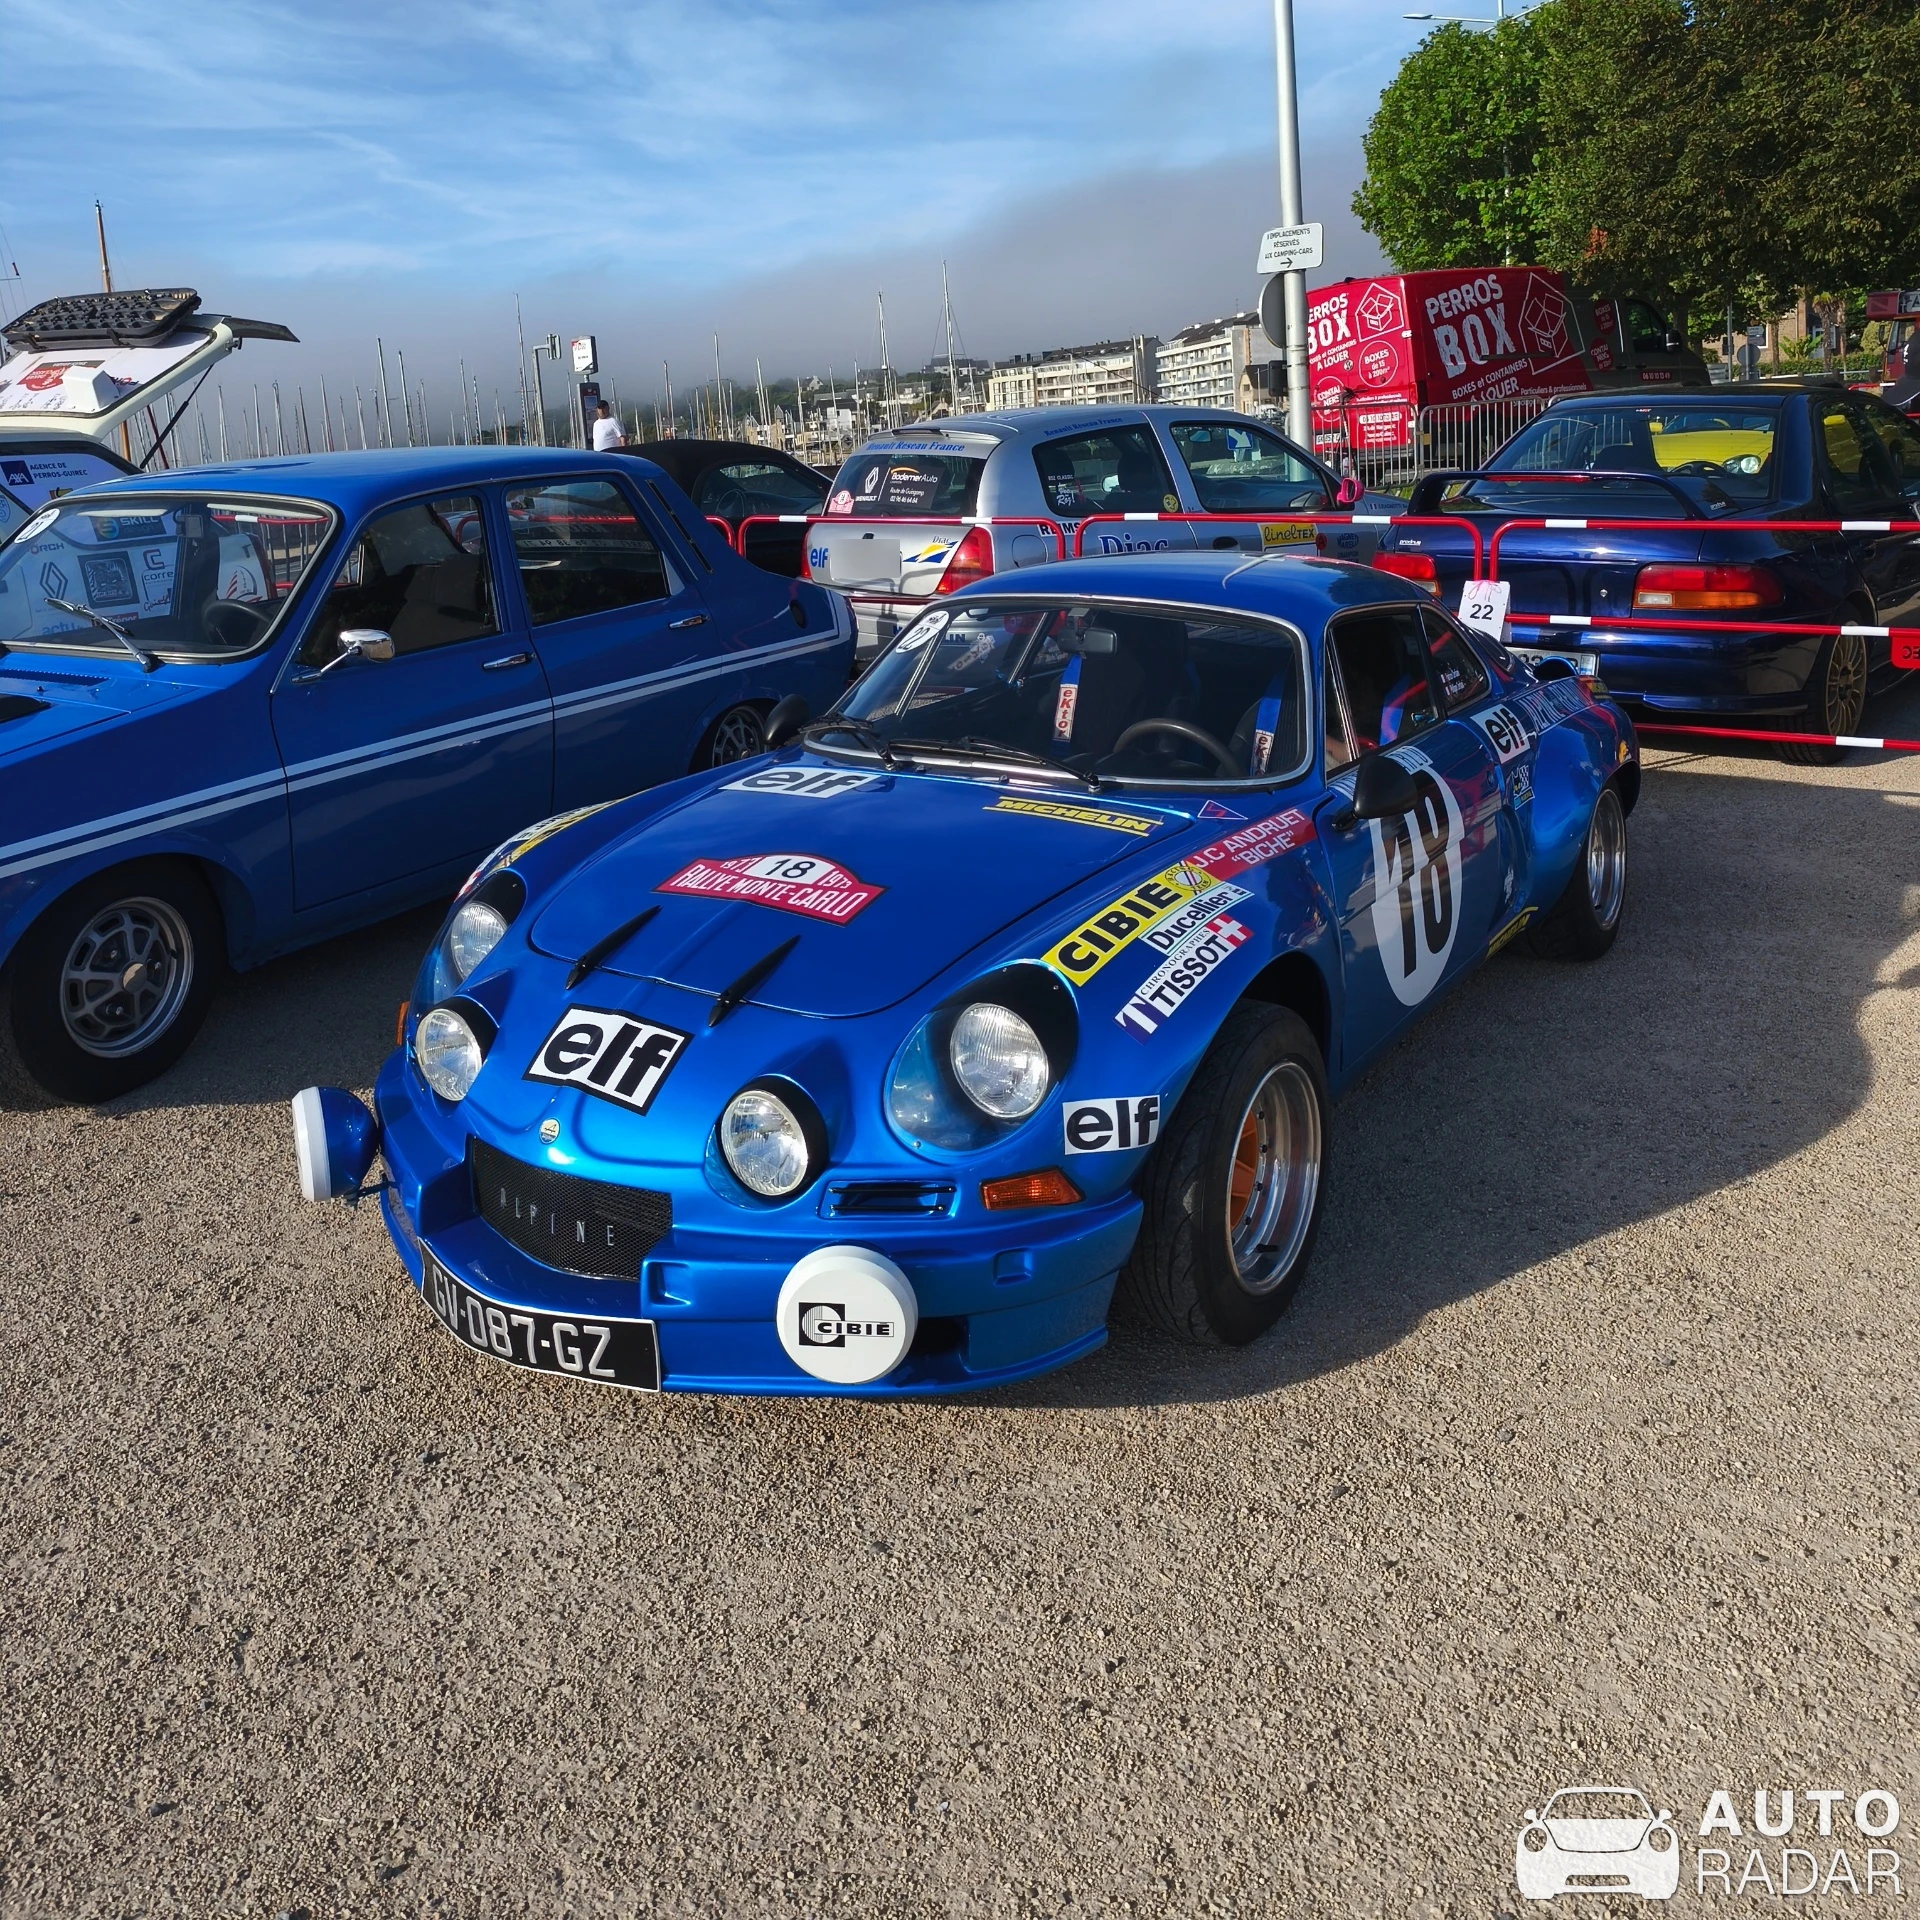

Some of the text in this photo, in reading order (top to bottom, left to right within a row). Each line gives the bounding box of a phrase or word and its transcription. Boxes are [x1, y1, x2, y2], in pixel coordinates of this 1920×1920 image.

[1273, 247, 1313, 258] CAMPING-CARS
[1308, 293, 1349, 324] ERROS
[1425, 273, 1503, 324] PERROS
[1308, 309, 1351, 355] BOX
[1328, 339, 1357, 355] CONTAINERS
[1433, 302, 1516, 379] BOX
[1324, 350, 1349, 368] LOUER
[1364, 349, 1389, 364] BOXES
[1372, 360, 1385, 370] de 15
[1317, 386, 1341, 400] CONTAI
[1452, 359, 1528, 400] BOXES et CONTAINERS
[1520, 387, 1548, 395] Particuliers
[1554, 382, 1587, 394] professionnels
[1044, 425, 1072, 436] Renault
[1098, 417, 1124, 425] France
[866, 442, 894, 451] Renault
[930, 442, 965, 452] France
[8, 472, 29, 483] AXA
[34, 470, 88, 478] PERROS-GUIREC
[1040, 522, 1081, 536] RMS
[810, 548, 829, 568] elf
[1469, 603, 1494, 621] 22
[1485, 708, 1525, 754] elf
[742, 770, 866, 796] elf
[996, 800, 1150, 830] MICHELIN
[1193, 809, 1306, 868] J.C ANDRUET
[765, 858, 816, 878] 18
[818, 870, 852, 889] 1973
[1380, 768, 1452, 979] 18
[670, 864, 868, 917] RALLYE MONTE-CARLO
[1147, 891, 1233, 951] Ducellier
[1140, 929, 1210, 996] CHRONOGRAPHES
[1149, 934, 1229, 1008] TISSOT
[543, 1023, 678, 1097] elf
[1065, 1098, 1159, 1152] elf
[500, 1187, 614, 1246] ALPINE
[432, 1264, 616, 1378] GV-087-GZ
